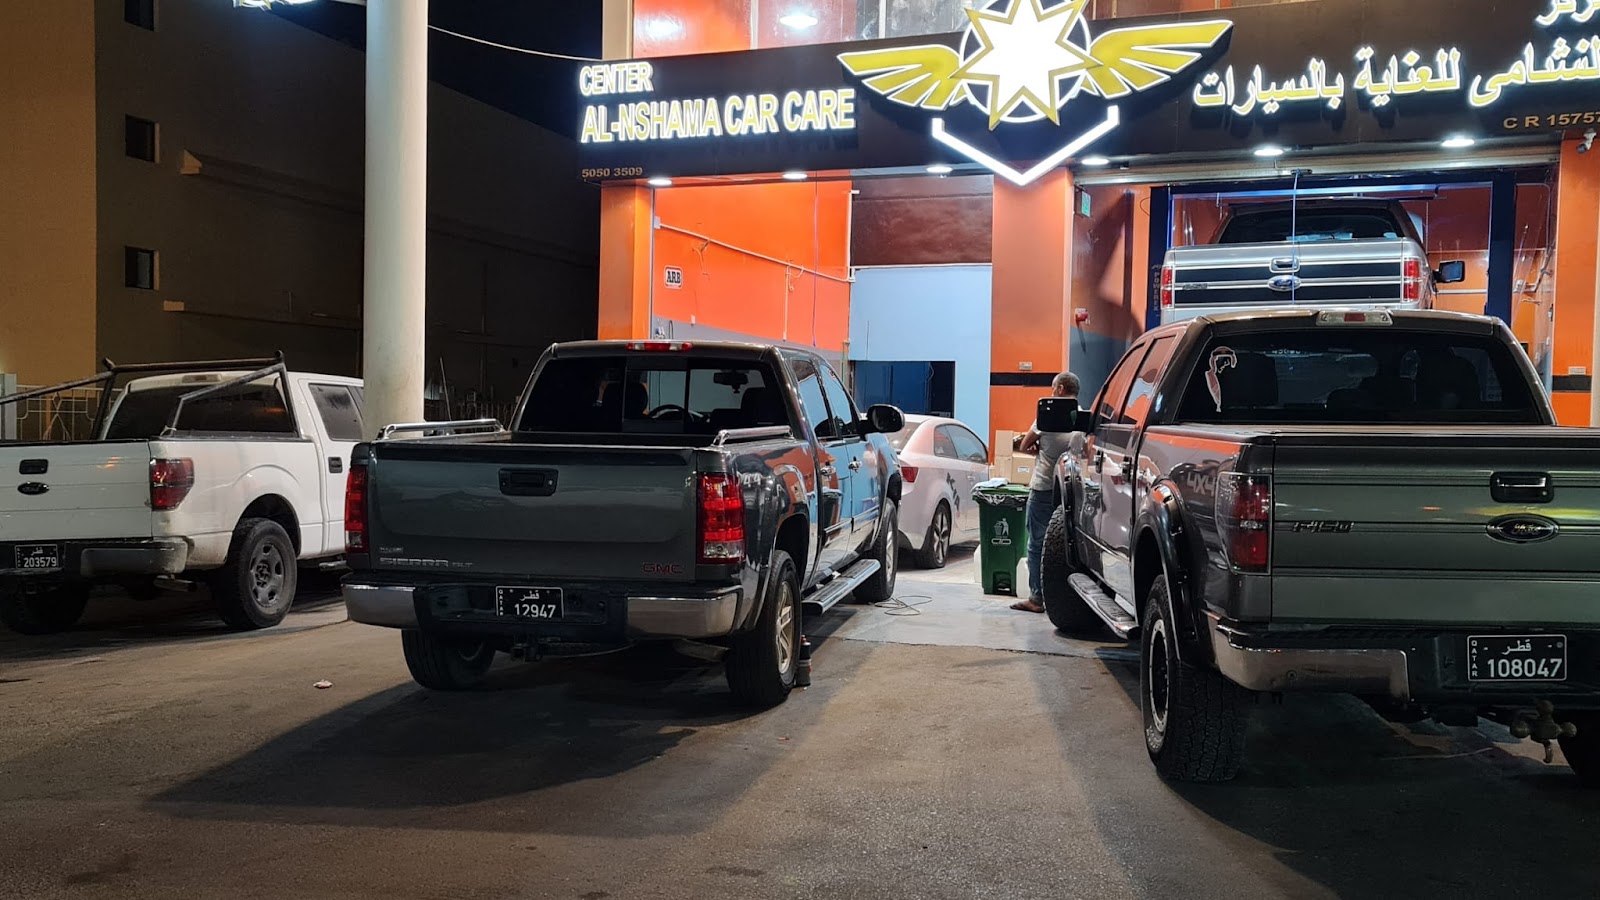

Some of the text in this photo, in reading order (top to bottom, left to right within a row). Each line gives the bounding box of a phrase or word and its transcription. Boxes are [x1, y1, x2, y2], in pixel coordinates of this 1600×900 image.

[579, 62, 653, 96] CENTER
[1353, 46, 1461, 107] للعناية
[1193, 57, 1345, 115] بالسيارات
[581, 88, 855, 143] AL-NSHAMA CAR CARE
[581, 167, 643, 178] 5050 3509
[666, 270, 681, 284] ARB
[23, 556, 57, 568] 203579
[642, 561, 684, 575] GMC
[520, 589, 540, 602] قطر
[514, 603, 557, 619] 12947
[1501, 639, 1532, 655] قطر
[1487, 658, 1563, 678] 108047
